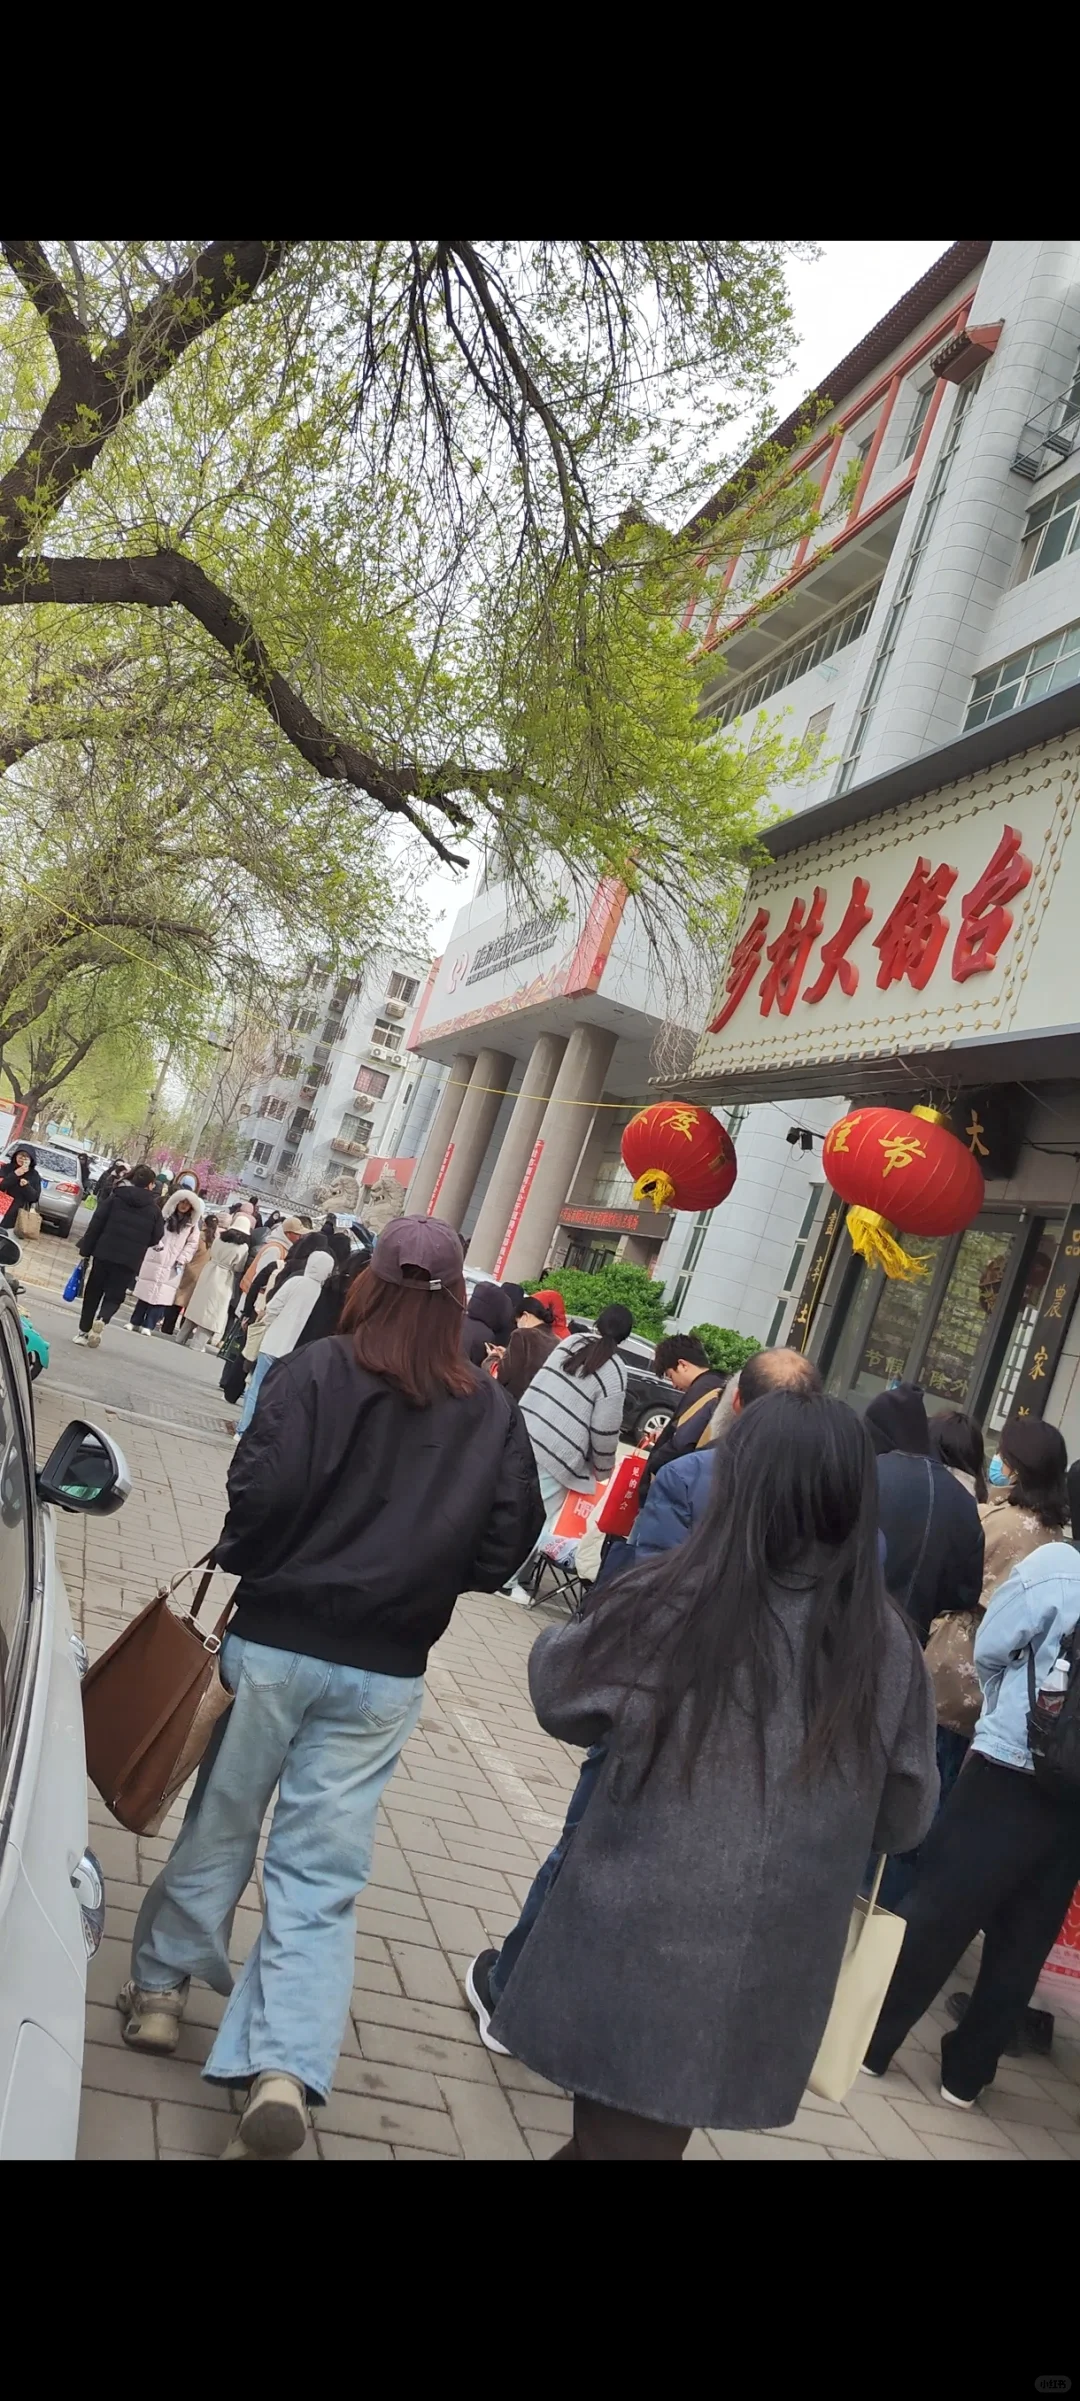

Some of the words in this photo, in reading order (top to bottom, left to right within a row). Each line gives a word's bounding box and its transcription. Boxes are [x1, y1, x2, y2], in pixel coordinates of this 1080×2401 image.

[707, 823, 1034, 1035] 乡村大锅台
[826, 1115, 927, 1178] 佳节
